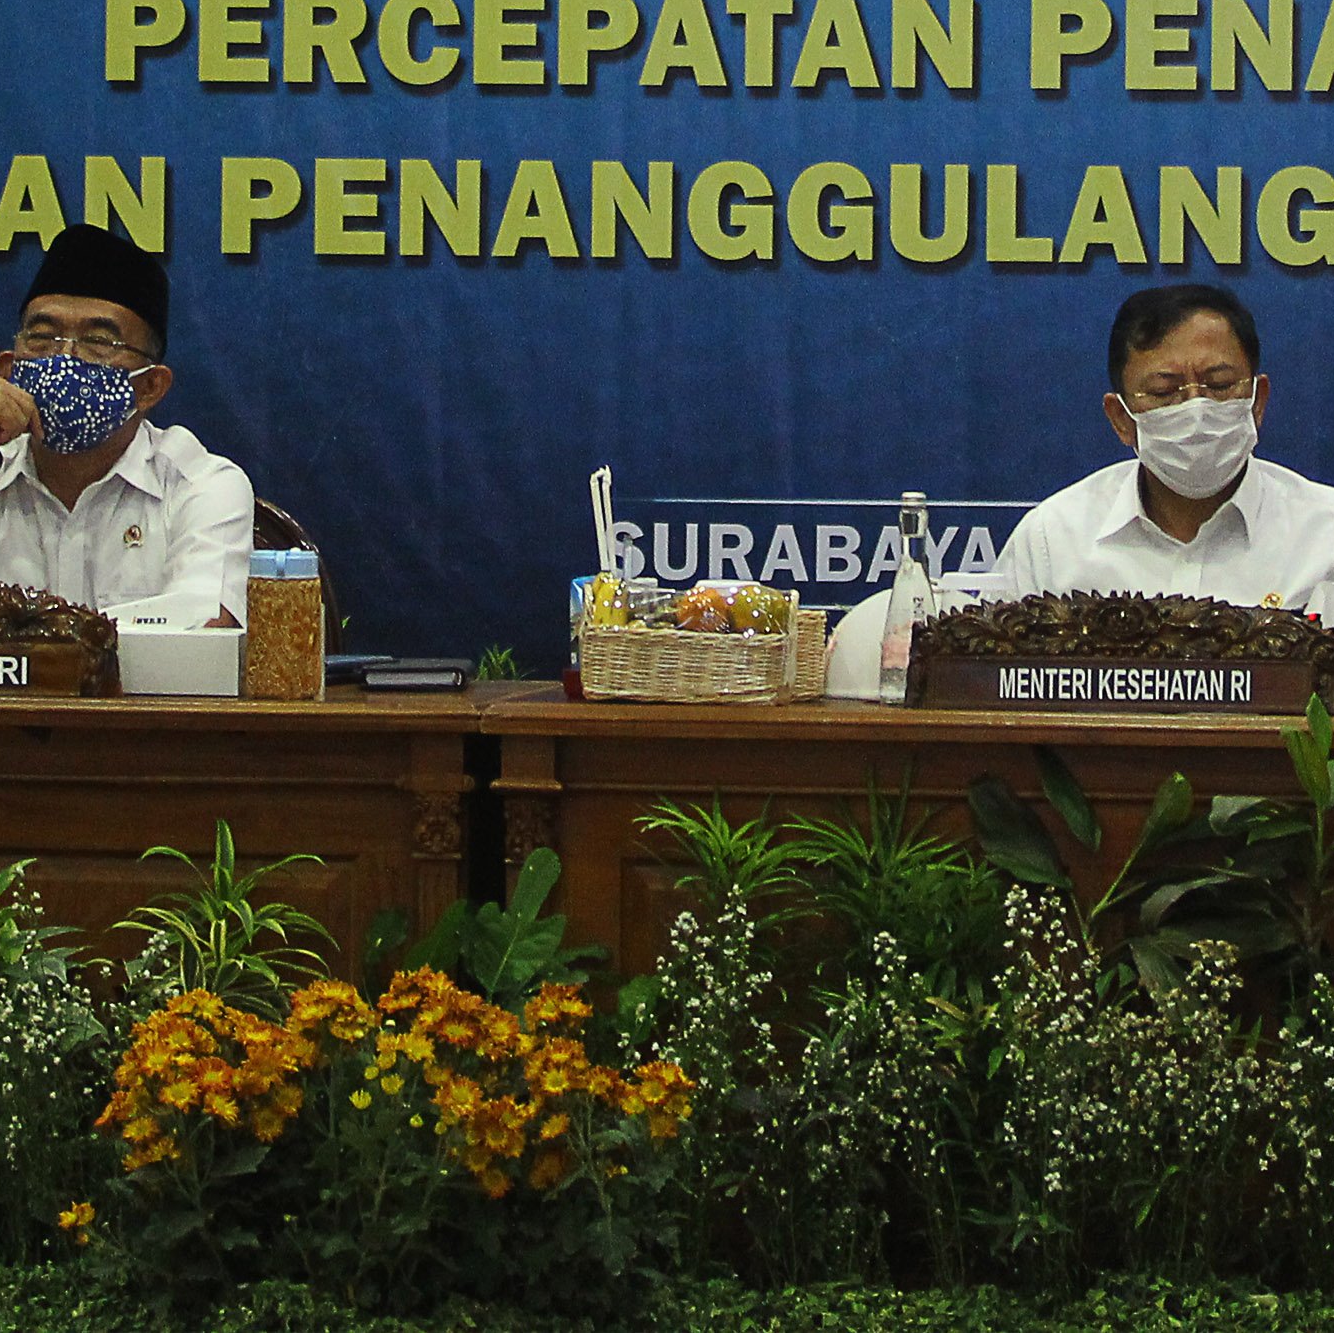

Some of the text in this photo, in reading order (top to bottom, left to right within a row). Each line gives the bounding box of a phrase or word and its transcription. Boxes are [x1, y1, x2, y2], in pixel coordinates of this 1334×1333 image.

[612, 521, 998, 582] SURABAYA
[999, 668, 1251, 702] MENTERI KESEHATAN RI
